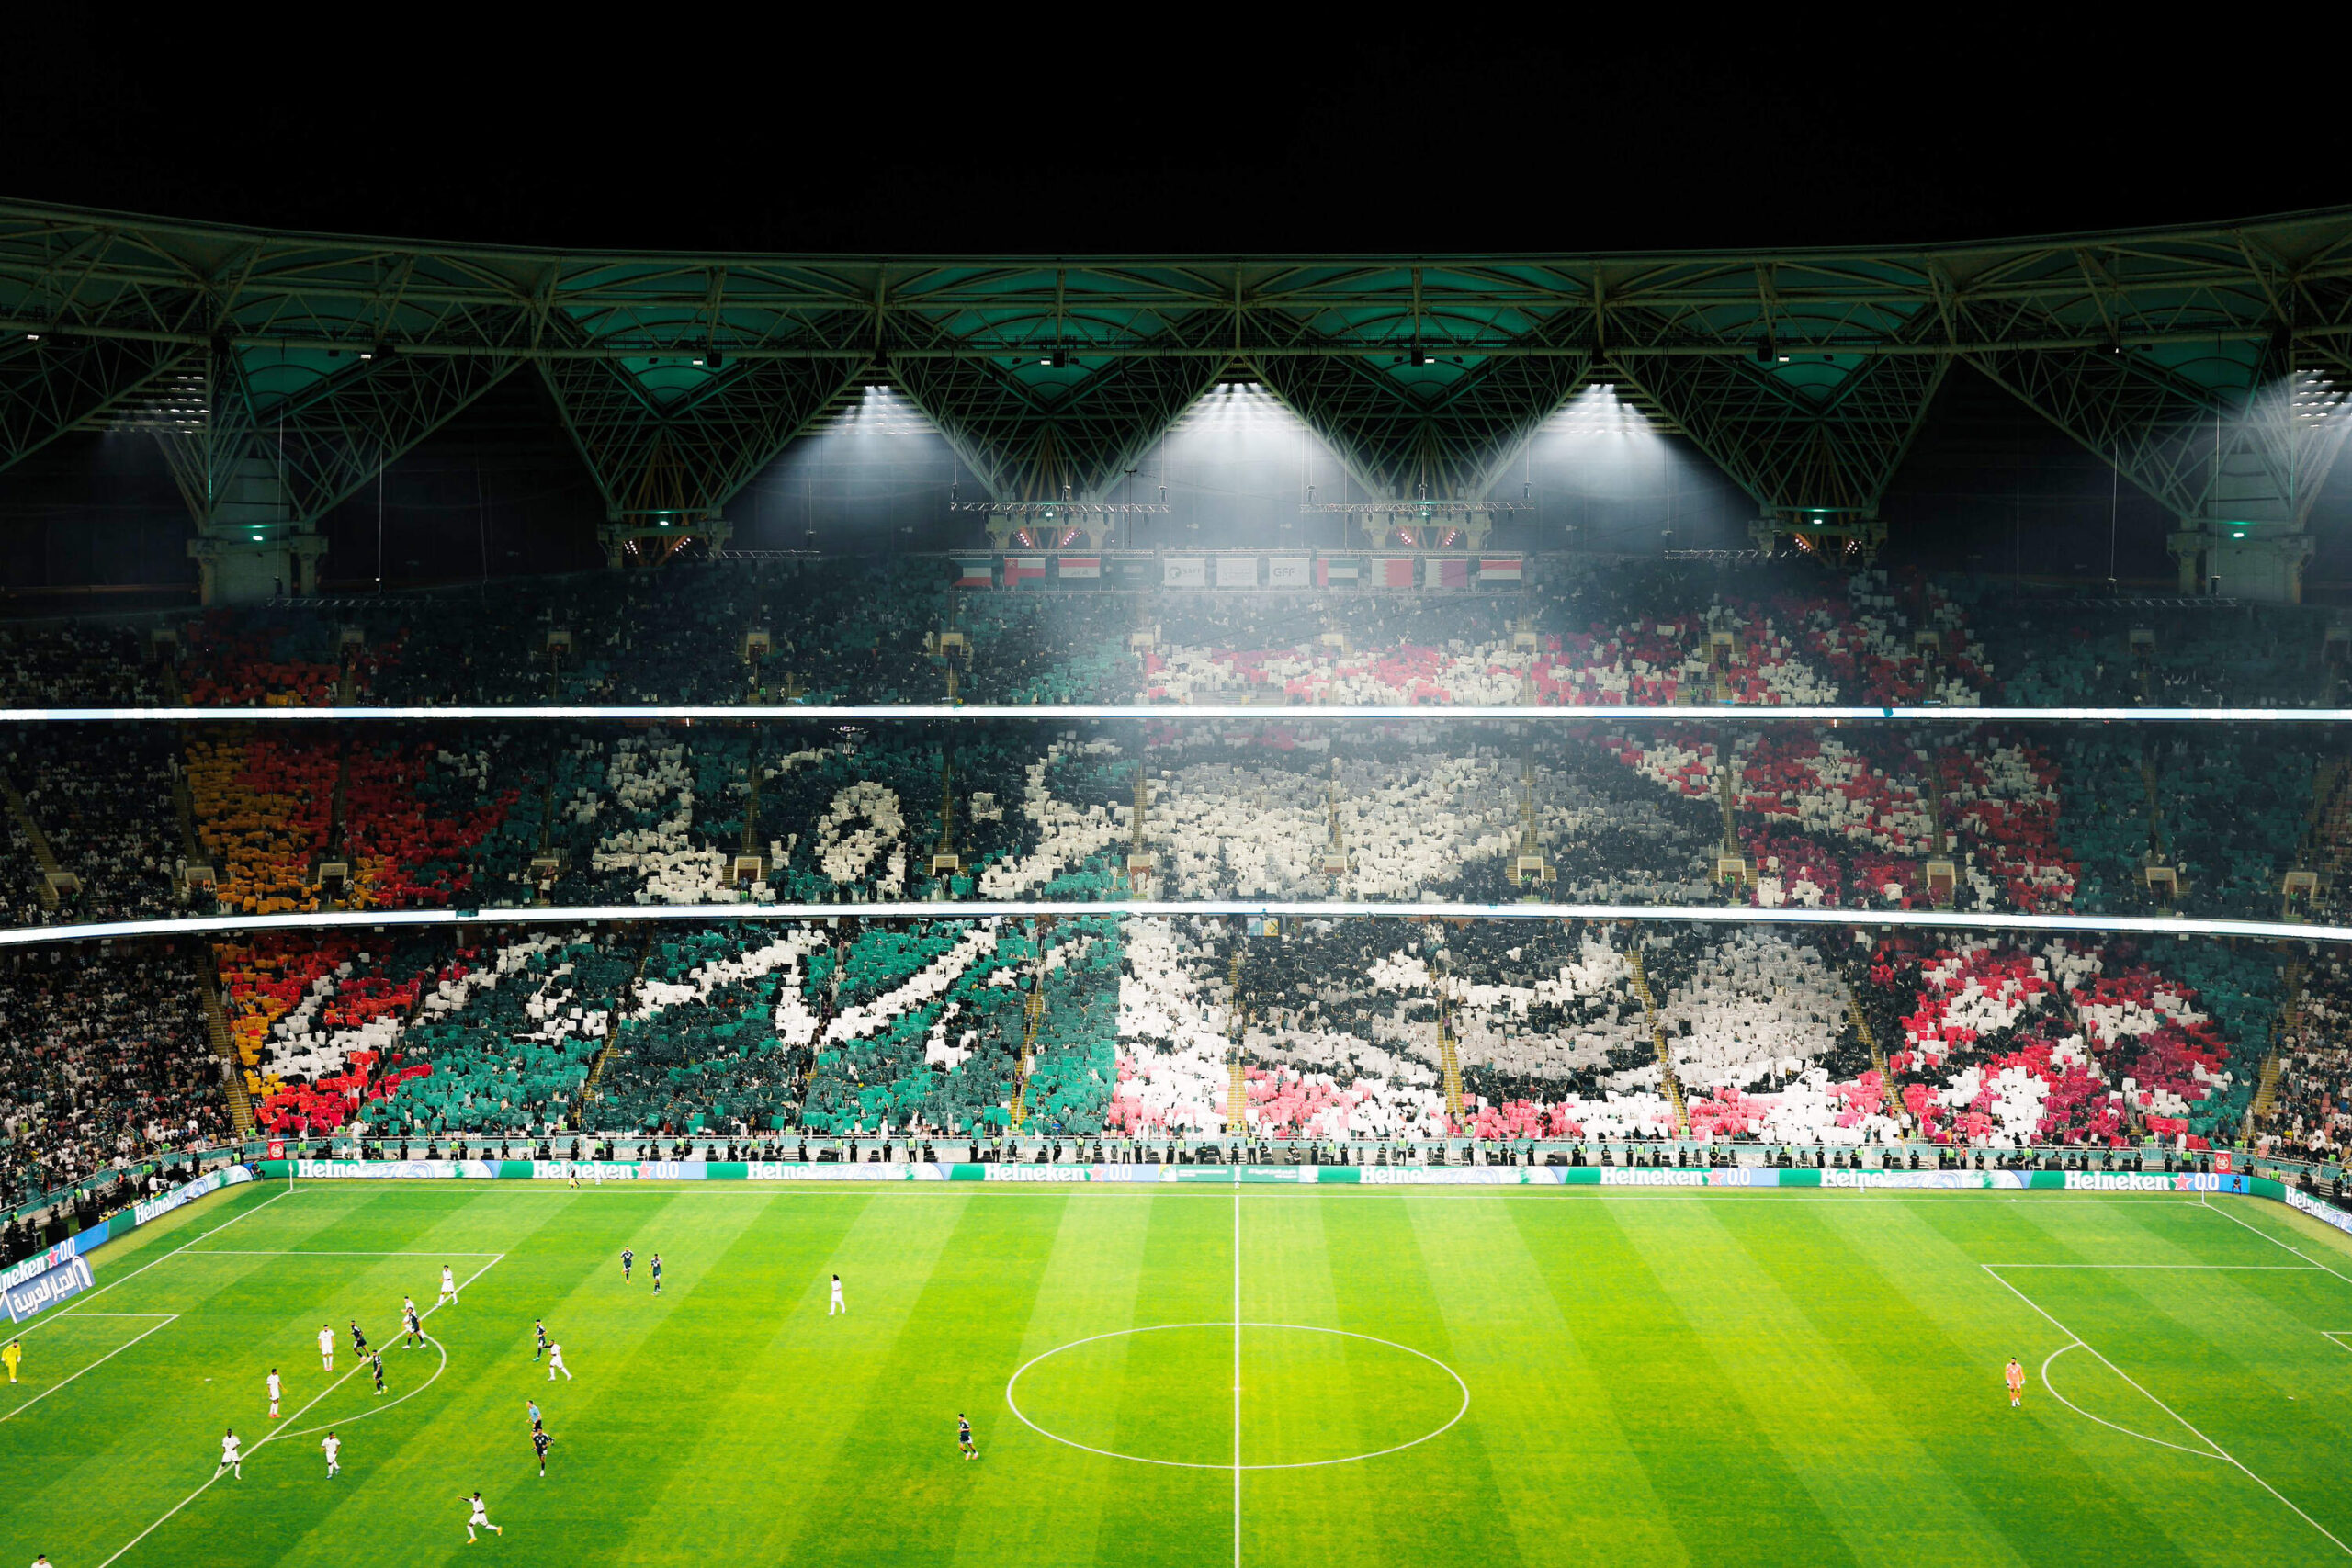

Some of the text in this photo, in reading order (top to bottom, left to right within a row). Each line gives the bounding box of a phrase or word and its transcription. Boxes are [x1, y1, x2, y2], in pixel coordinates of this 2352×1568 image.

[983, 1163, 1086, 1181] Heineken
[1600, 1167, 1703, 1185] Heineken
[2064, 1171, 2170, 1190] Heineken
